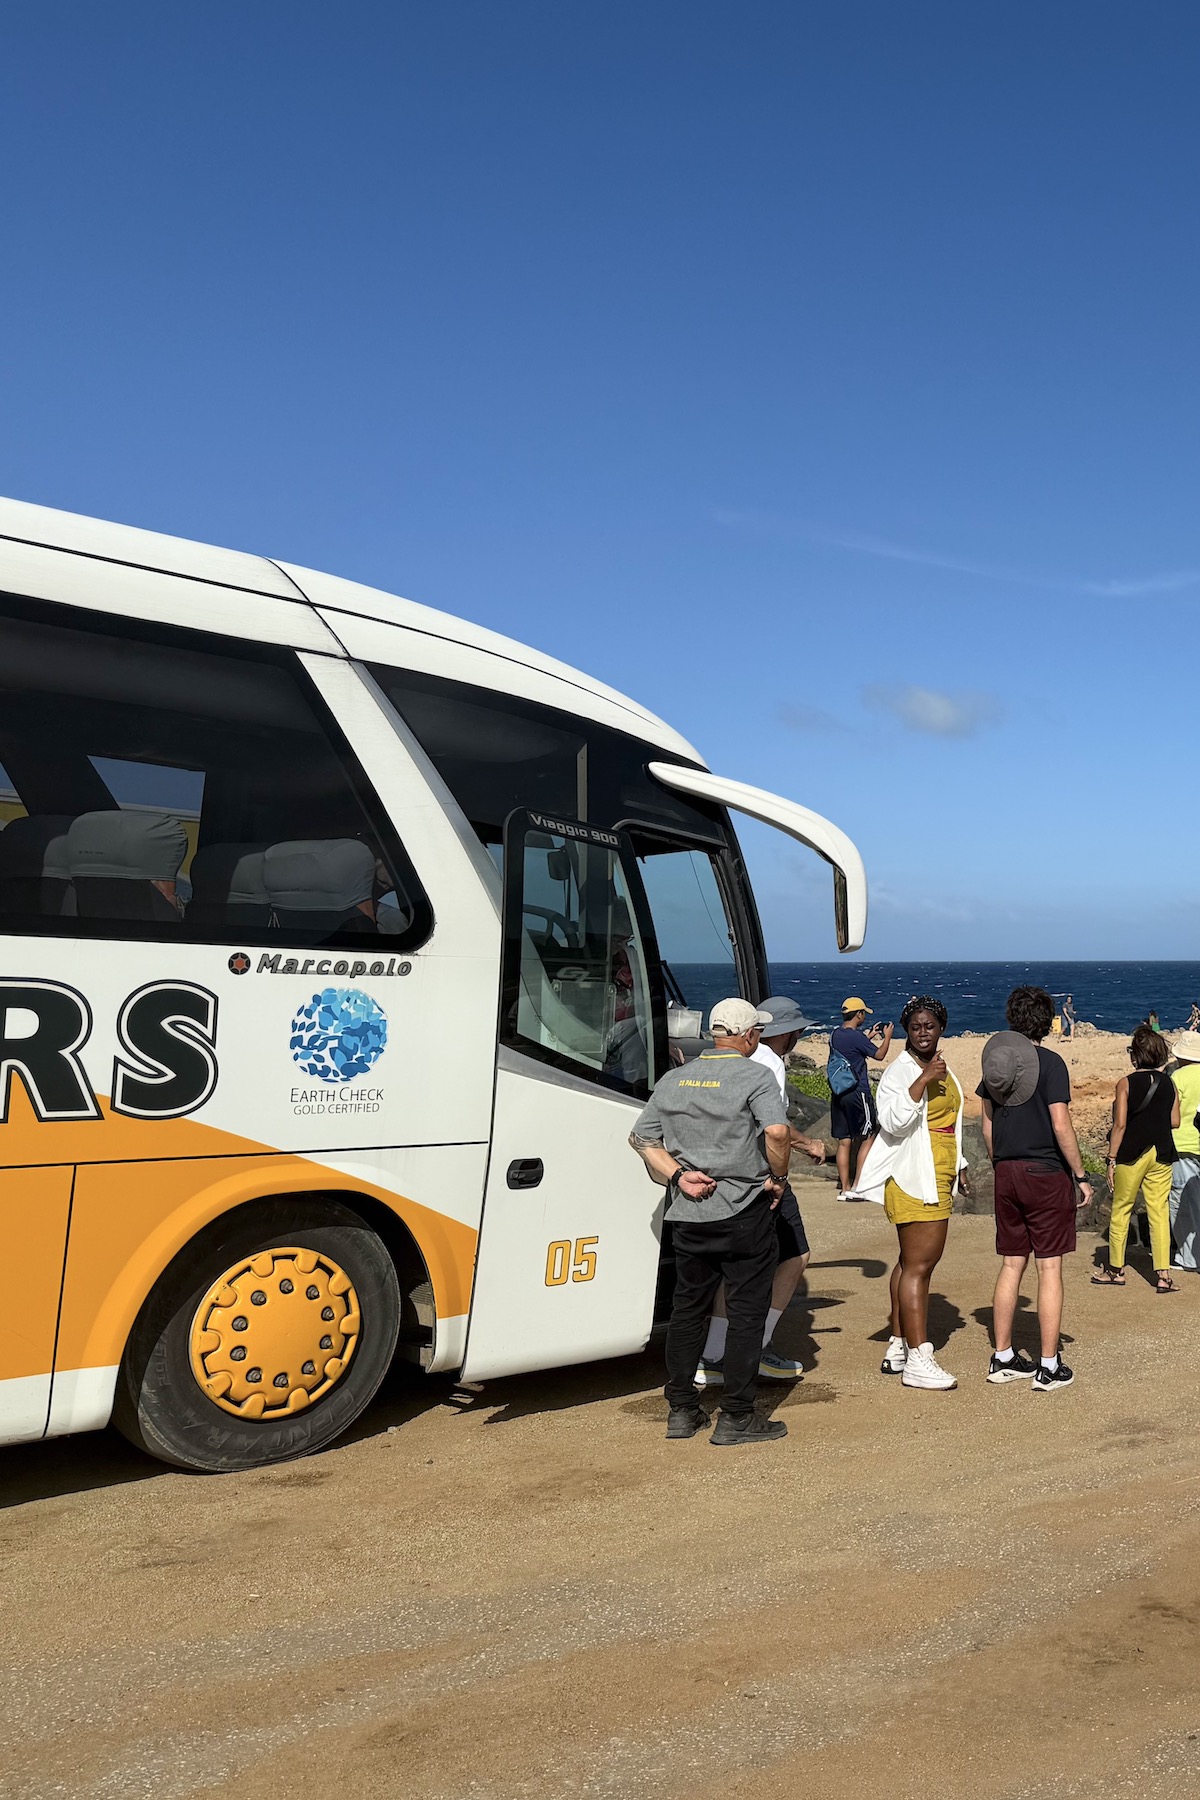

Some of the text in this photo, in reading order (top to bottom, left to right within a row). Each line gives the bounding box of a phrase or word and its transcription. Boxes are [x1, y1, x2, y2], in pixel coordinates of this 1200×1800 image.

[530, 813, 619, 846] Viaggio 900
[256, 952, 413, 979] Marcopolo
[293, 1102, 380, 1115] GOLD CERTIFIED
[544, 1235, 600, 1287] 05
